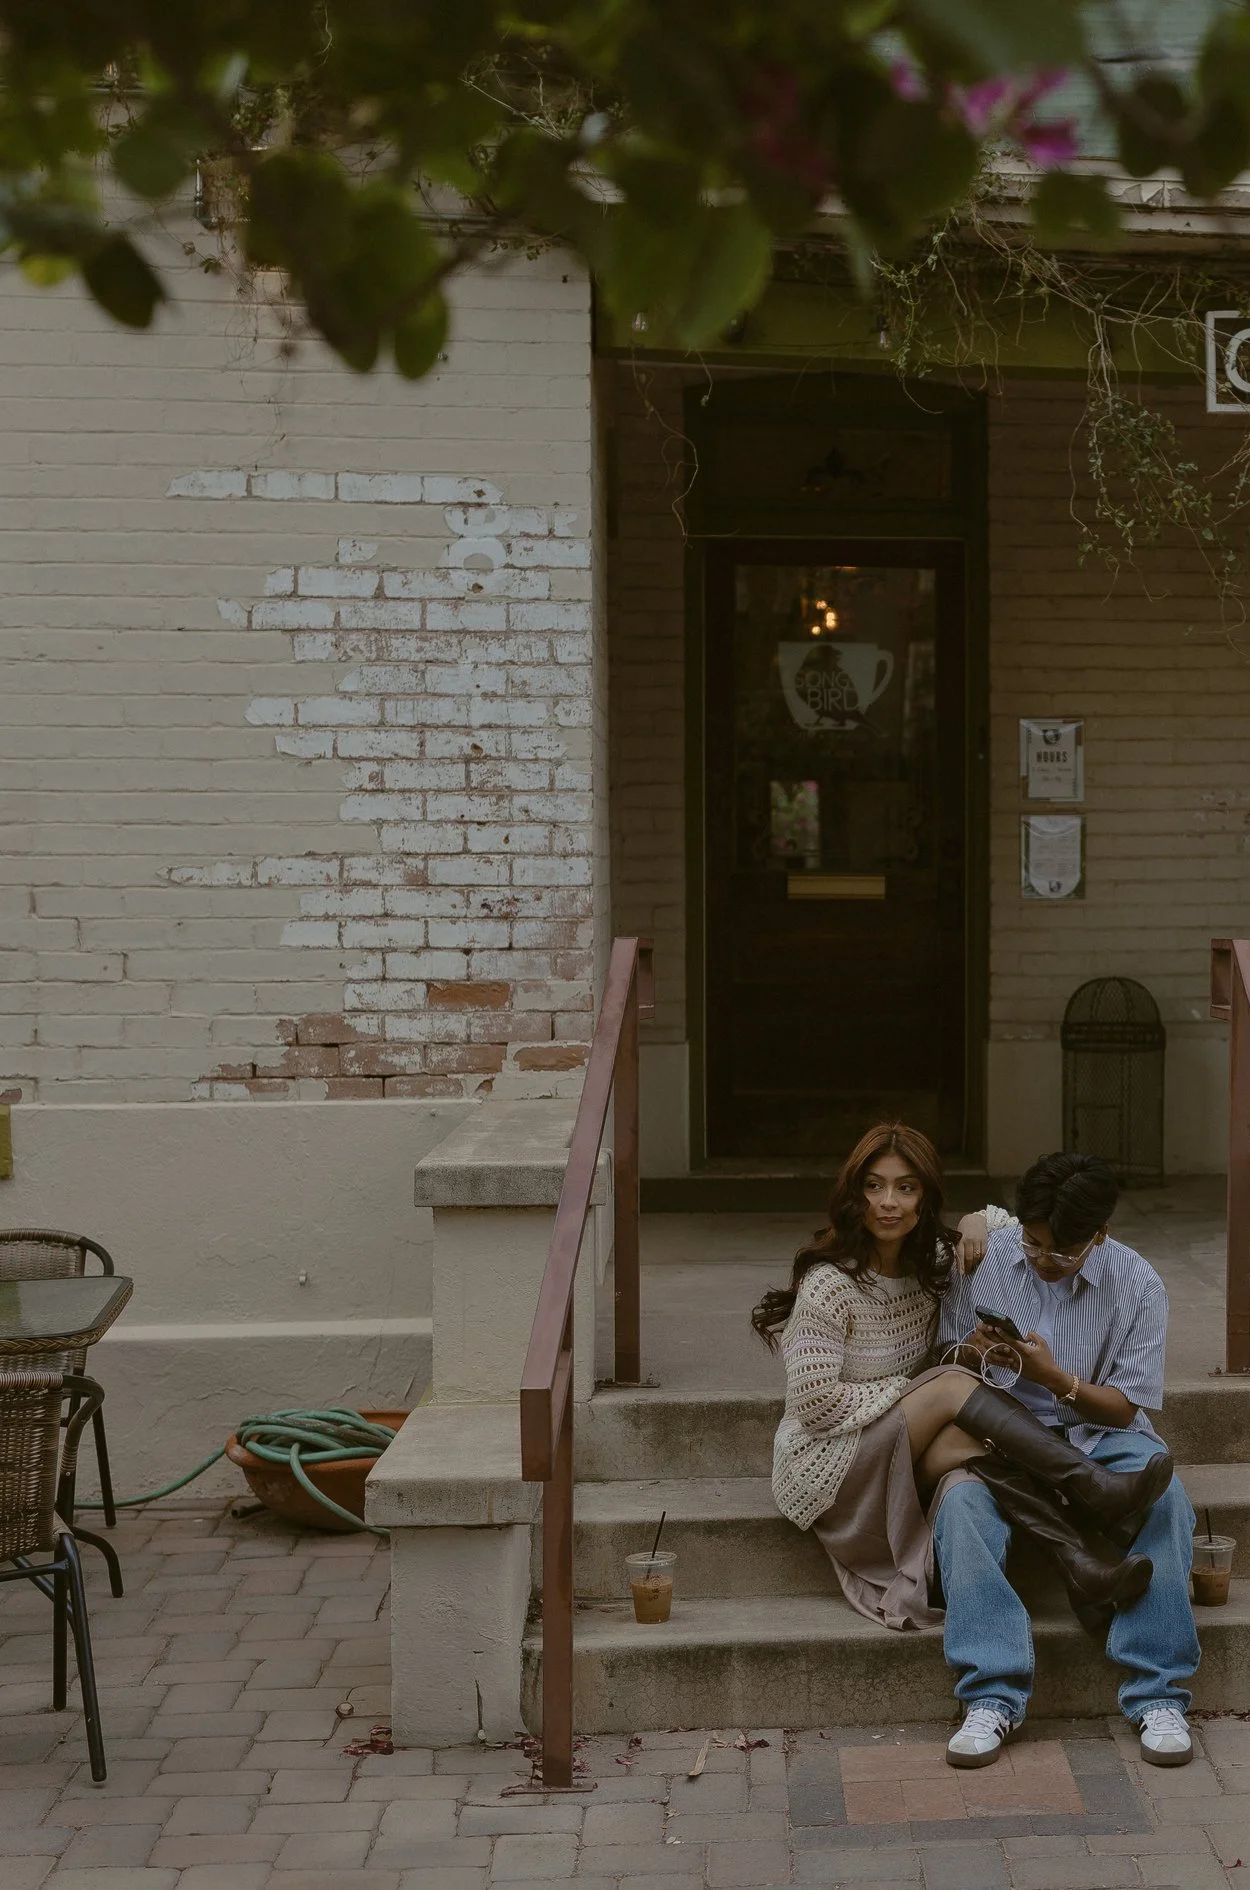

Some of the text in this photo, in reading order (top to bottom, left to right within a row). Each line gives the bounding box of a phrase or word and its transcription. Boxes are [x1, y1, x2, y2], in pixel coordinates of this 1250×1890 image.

[795, 670, 850, 688] SONG
[807, 687, 860, 712] BIRD
[1036, 751, 1068, 763] HOURS
